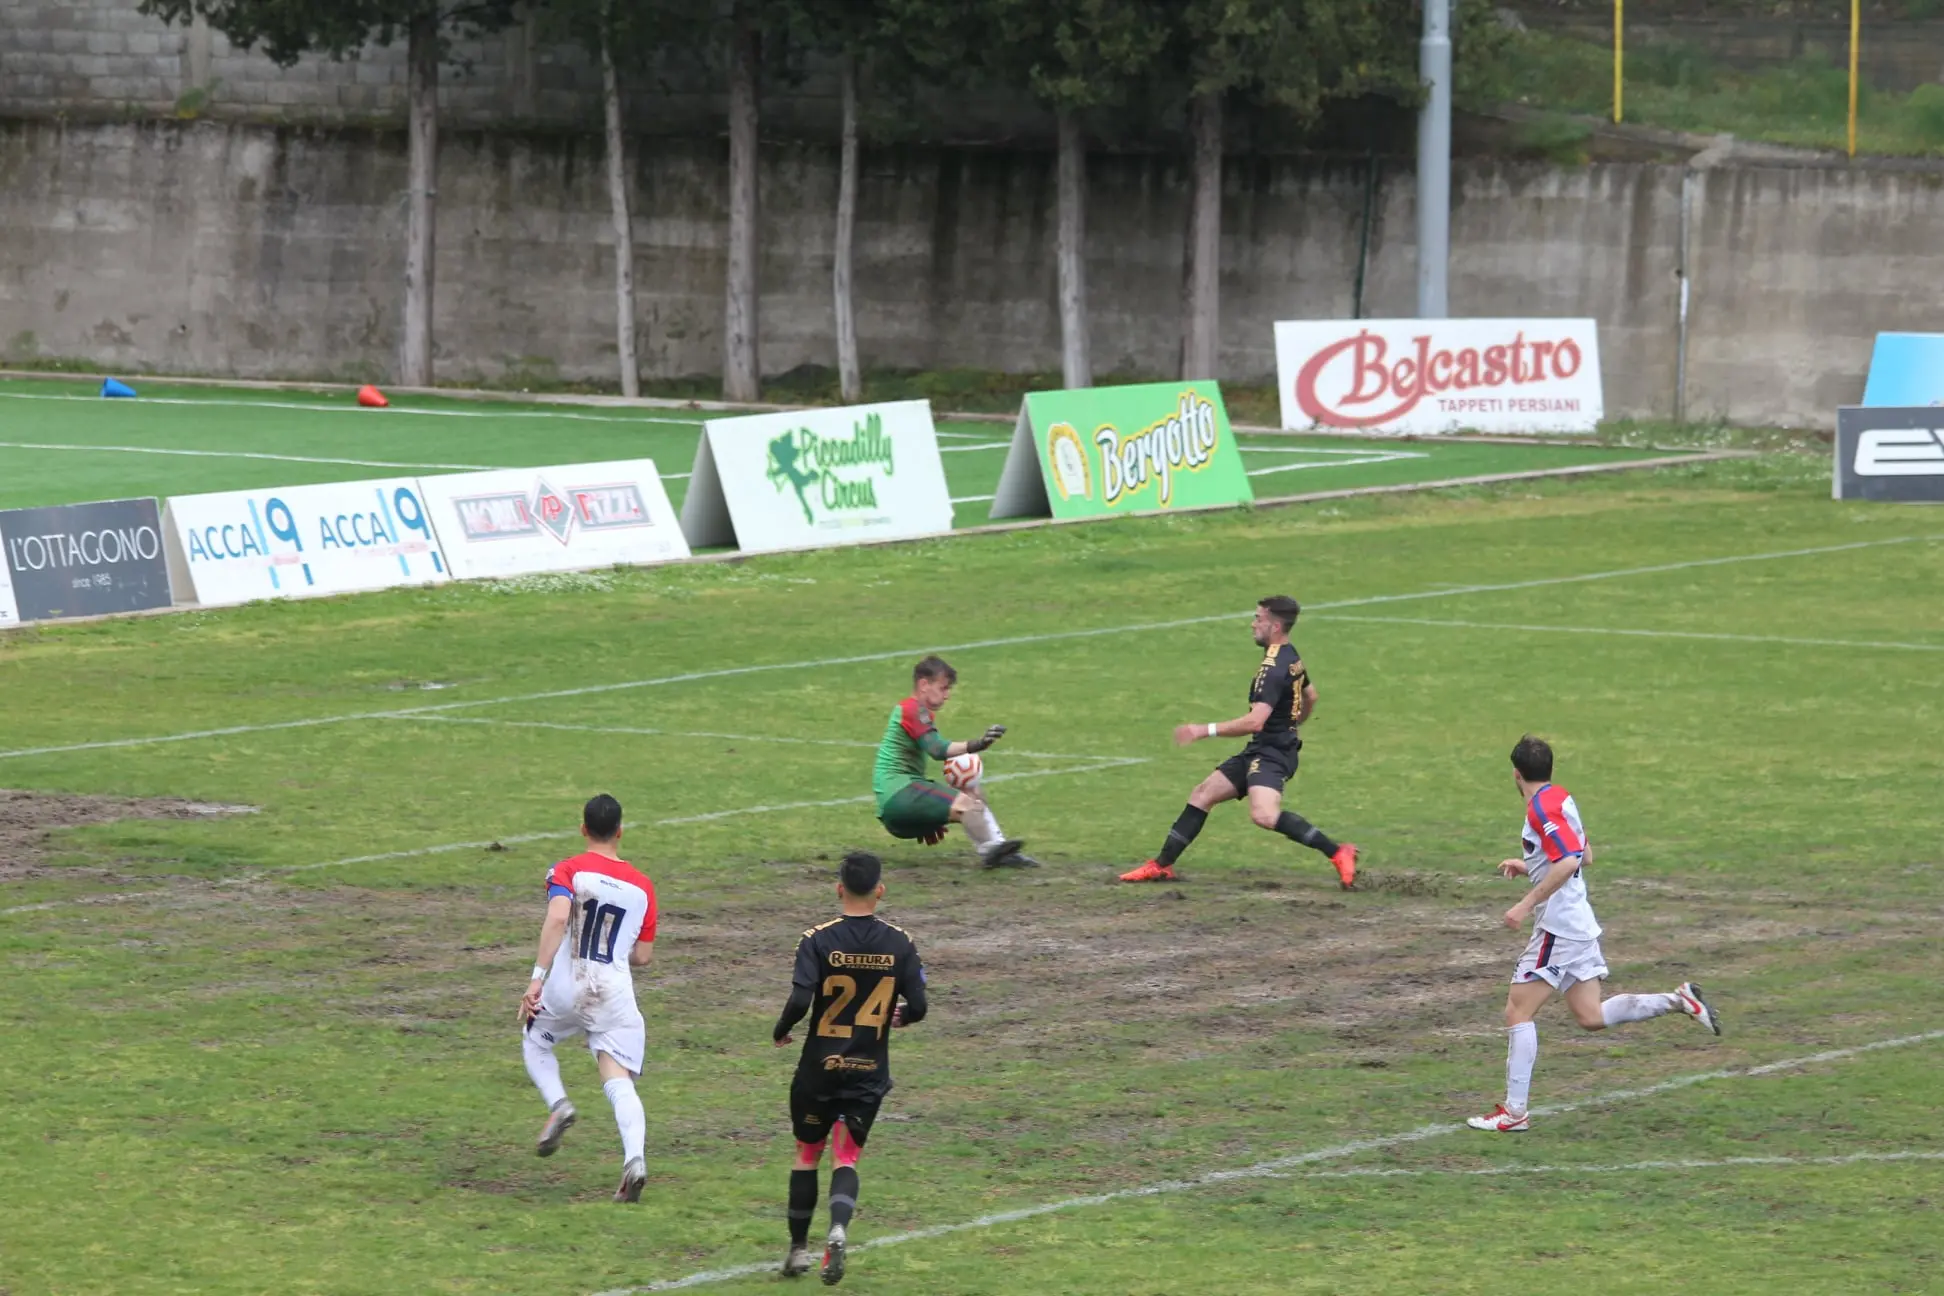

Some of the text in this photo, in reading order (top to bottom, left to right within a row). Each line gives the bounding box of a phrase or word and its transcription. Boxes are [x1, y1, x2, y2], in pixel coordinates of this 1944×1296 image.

[1295, 328, 1581, 427] Belcastro
[1437, 398, 1581, 413] TAPPETI PERSIANI
[800, 412, 894, 476] Piccadilly
[1096, 391, 1215, 503] Bergotto
[1853, 428, 1944, 476] E
[821, 468, 877, 510] Circus
[11, 526, 160, 573] L'OTTAGONO
[579, 898, 627, 964] 10
[831, 952, 892, 965] RETTURA
[816, 974, 896, 1040] 24
